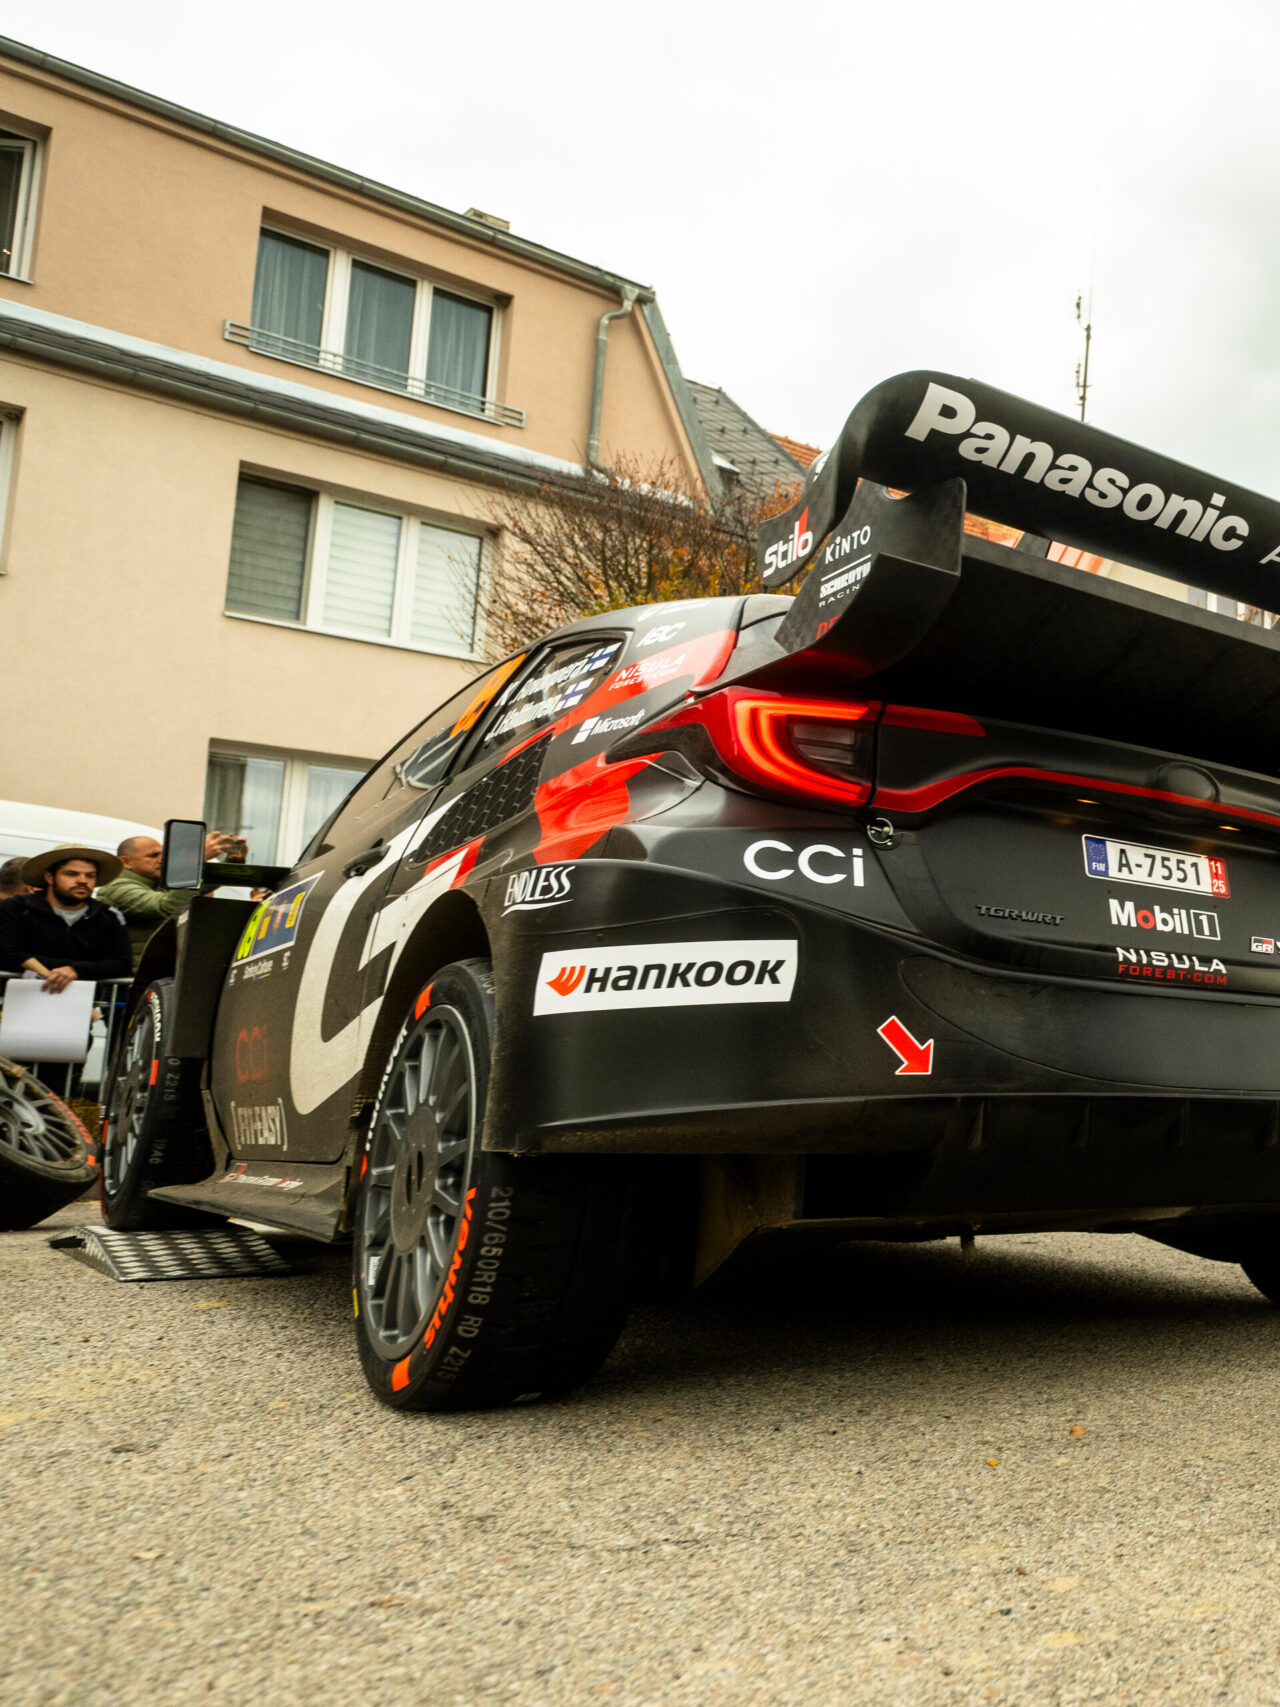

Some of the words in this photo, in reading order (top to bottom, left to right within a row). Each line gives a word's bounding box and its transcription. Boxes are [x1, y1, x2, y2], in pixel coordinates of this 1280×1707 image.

[905, 382, 1250, 550] Panasonic
[763, 520, 814, 578] Stilo
[819, 584, 860, 608] RACIN
[590, 709, 645, 736] Microsoft
[1092, 862, 1106, 872] FIN
[1117, 847, 1201, 886] A-7551
[1210, 861, 1222, 875] 11
[503, 865, 576, 907] ENDLESS
[1213, 879, 1226, 893] 25
[1109, 898, 1189, 935] Mobil
[1116, 946, 1228, 974] NISULA
[466, 1186, 514, 1306] 210/650R18
[456, 1315, 484, 1338] RD
